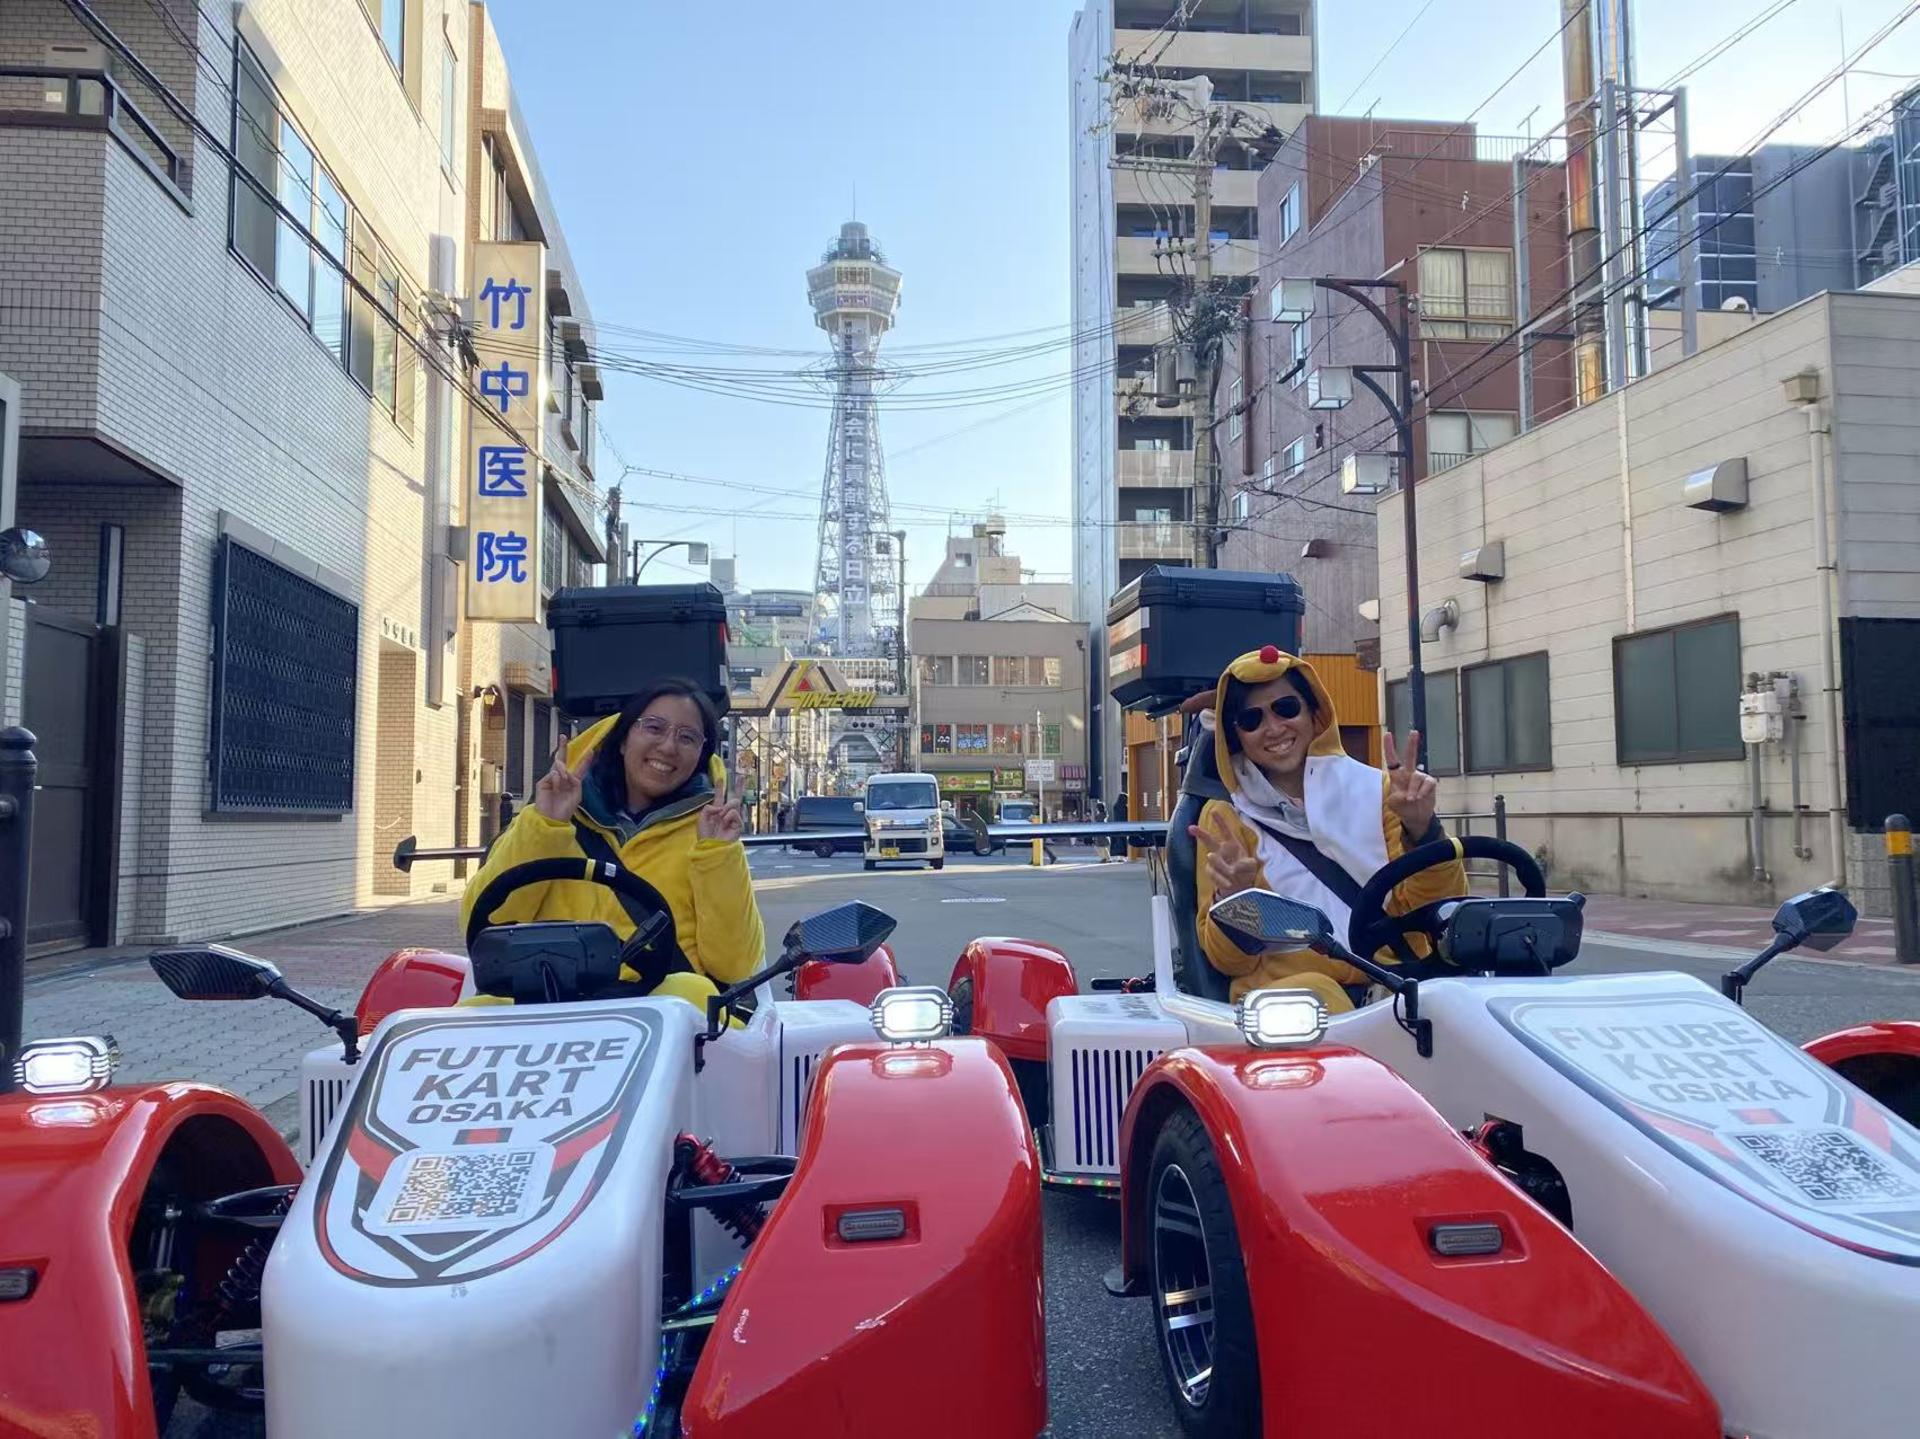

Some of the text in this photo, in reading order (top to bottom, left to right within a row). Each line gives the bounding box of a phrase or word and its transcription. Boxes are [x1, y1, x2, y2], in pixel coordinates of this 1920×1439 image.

[476, 277, 532, 583] 竹中医院
[1549, 1020, 1765, 1050] FUTURE
[399, 1037, 630, 1071] FUTURE
[1603, 1048, 1773, 1080] KART
[412, 1066, 595, 1100] KART
[1648, 1079, 1811, 1103] OSAKA
[407, 1097, 573, 1124] OSAKA
